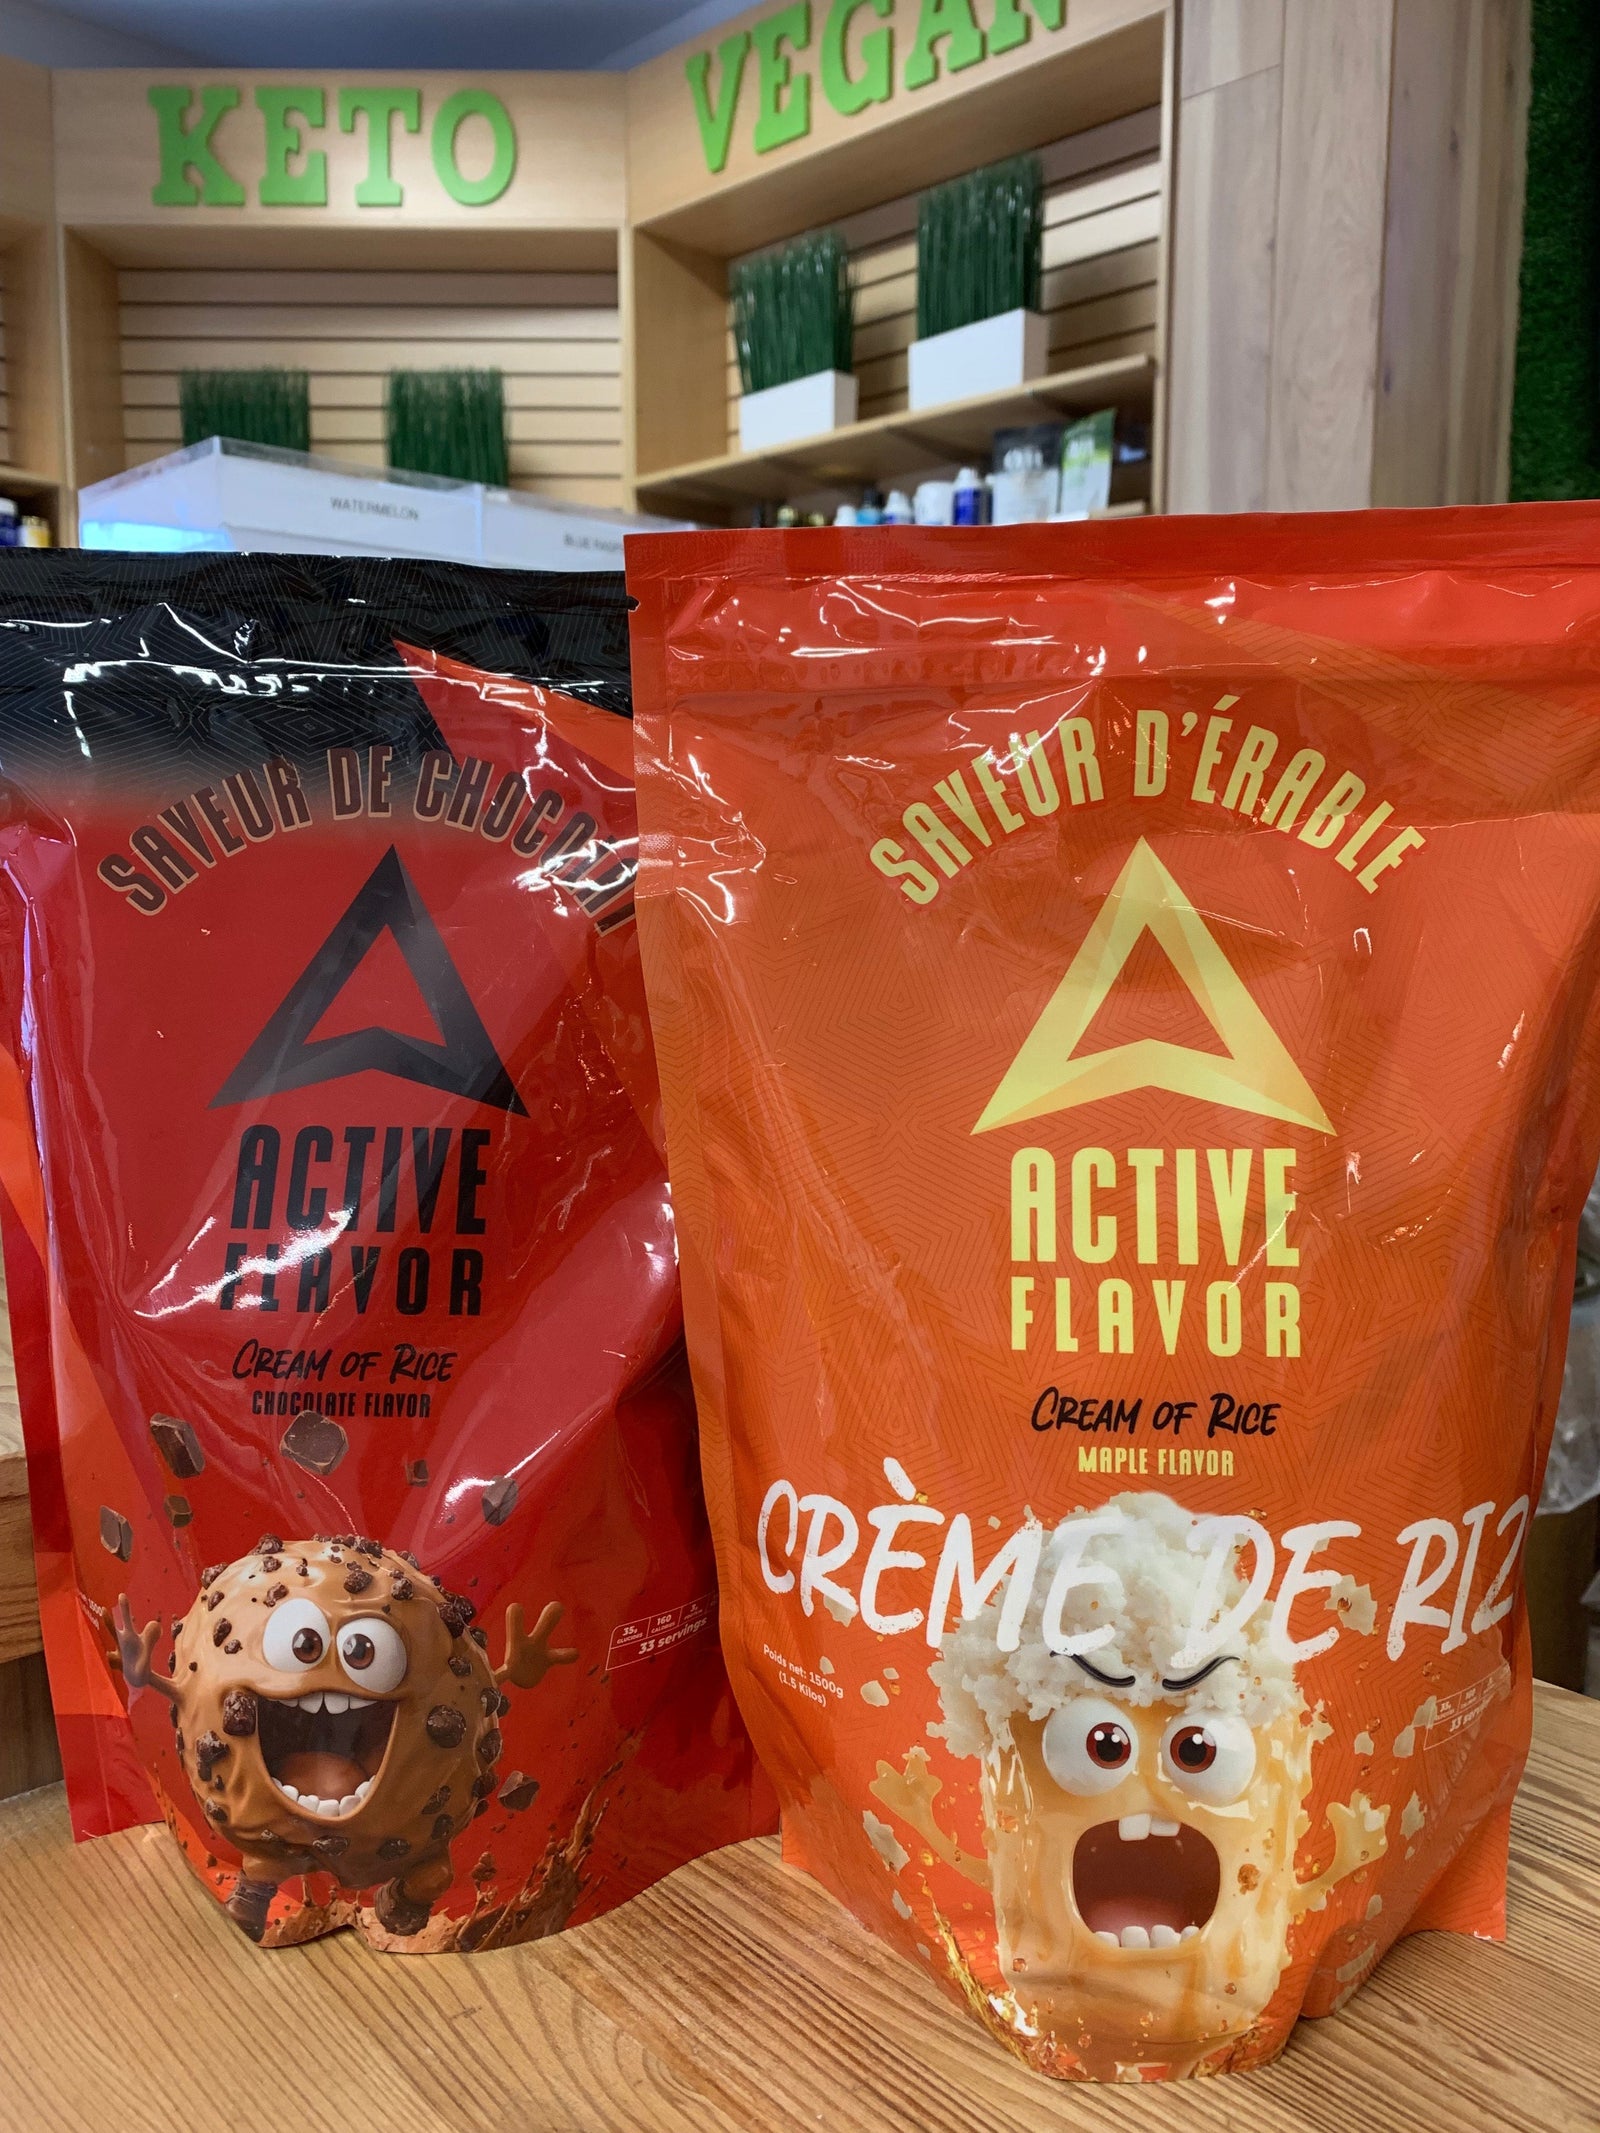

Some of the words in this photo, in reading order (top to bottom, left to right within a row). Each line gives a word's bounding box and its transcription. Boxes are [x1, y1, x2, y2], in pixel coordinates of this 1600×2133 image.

[147, 86, 518, 207] KETO
[330, 496, 419, 521] WATERMELON
[869, 716, 1105, 905] SAVEUR
[1133, 694, 1426, 894] D’ÉRABLE
[97, 757, 313, 917] SAVEUR
[326, 745, 394, 821] DE
[230, 1124, 491, 1235] ACTIVE
[1010, 1147, 1300, 1267] ACTIVE
[219, 1242, 484, 1316] FLAVOR
[1010, 1275, 1301, 1358] FLAVOR
[232, 1338, 332, 1382] CREAM
[340, 1351, 382, 1382] OF
[389, 1343, 458, 1385] RICE
[252, 1390, 356, 1417] CHOCOLATE
[364, 1393, 431, 1419] FLAVOR
[1030, 1386, 1142, 1434] CREAM
[1152, 1401, 1198, 1435] OF
[1207, 1392, 1282, 1439] RICE
[1078, 1446, 1148, 1475] MAPLE
[1158, 1448, 1234, 1477] FLAVOR
[757, 1457, 1137, 1656] CRÈME
[1170, 1514, 1362, 1668] DE
[1386, 1494, 1530, 1662] RIZ
[638, 1639, 655, 1654] 33
[657, 1617, 708, 1648] servings
[657, 1614, 672, 1626] 160
[763, 1643, 787, 1667] Poids
[789, 1662, 807, 1678] net:
[809, 1671, 844, 1699] 1500g
[779, 1670, 797, 1689] (1.5
[799, 1682, 827, 1708] Kilos)
